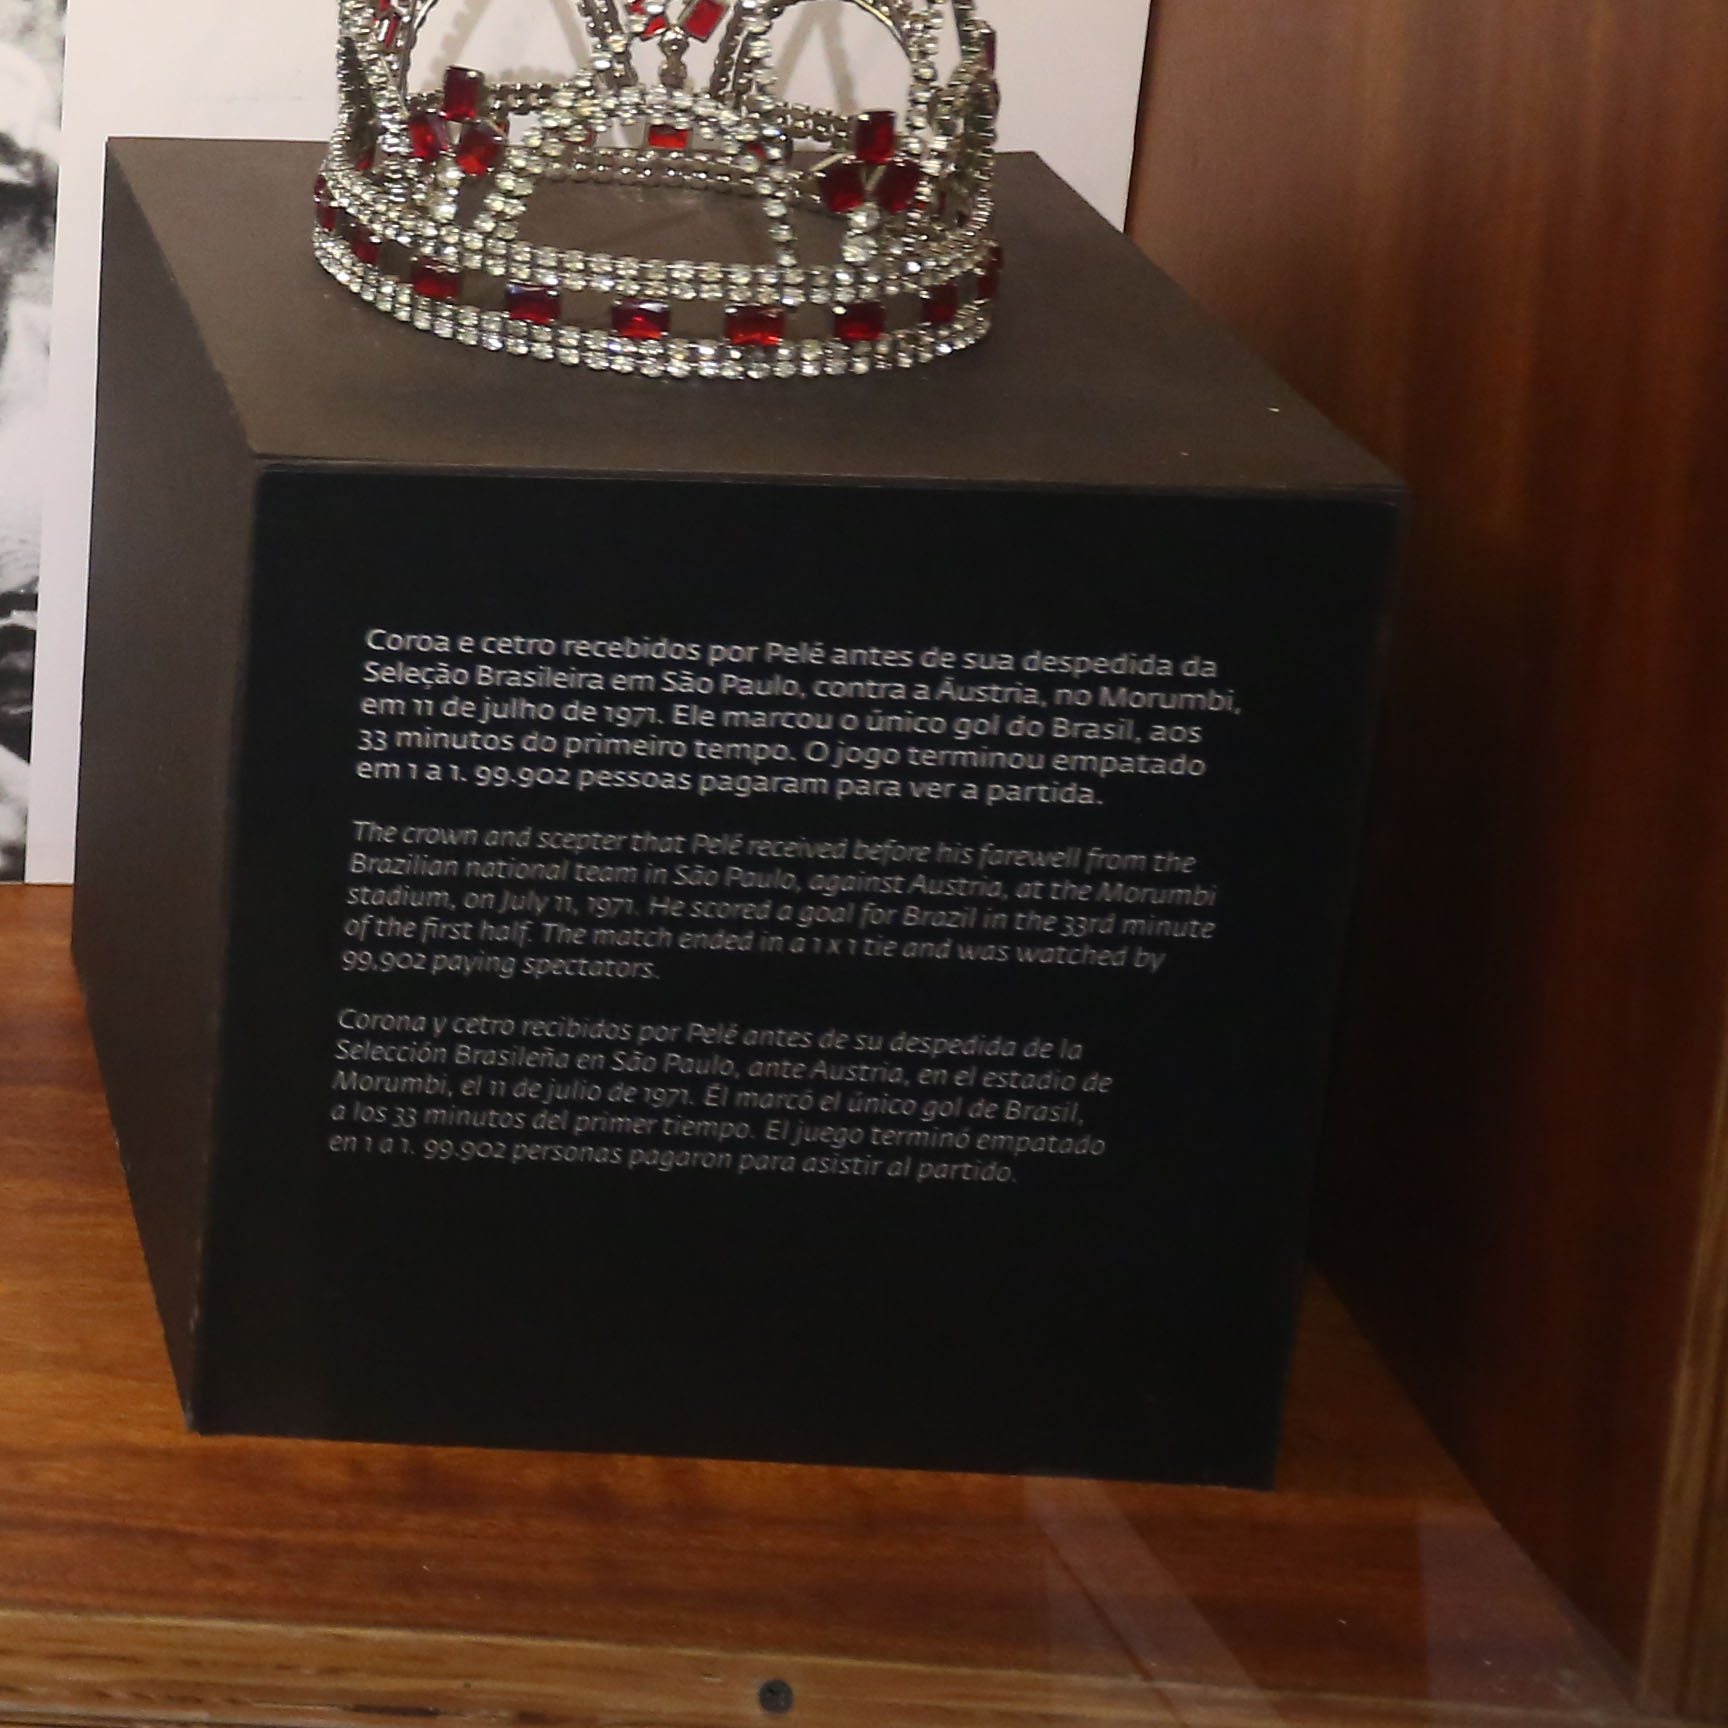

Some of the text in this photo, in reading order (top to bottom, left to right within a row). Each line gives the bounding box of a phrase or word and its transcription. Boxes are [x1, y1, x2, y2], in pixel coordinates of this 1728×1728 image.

[364, 628, 1218, 678] Coroa e cetro recebidos por Pelé antes de sua despedida da
[356, 728, 388, 752] 33
[394, 730, 515, 752] minutos
[520, 730, 558, 753] do
[562, 735, 688, 759] primeiro
[803, 739, 830, 762] O
[830, 745, 901, 770] jogo
[906, 745, 1045, 770] terminou
[1050, 753, 1207, 778] empatado
[351, 818, 1198, 874] The crown and scepter that Pelé received before his farewell from the
[336, 1007, 1085, 1061] Corona y cetro recibidos por Pelé antes de su despedida de la
